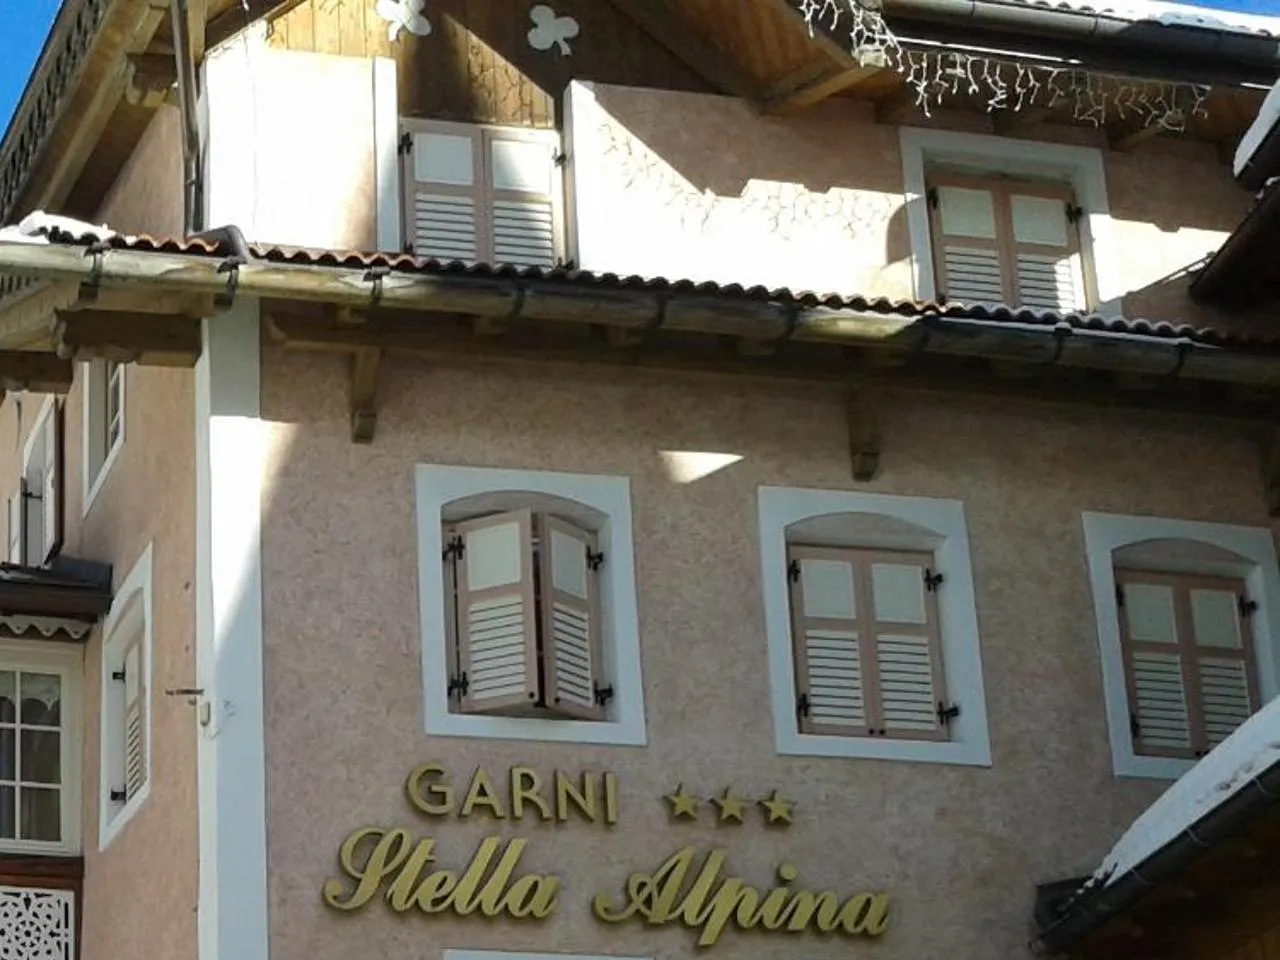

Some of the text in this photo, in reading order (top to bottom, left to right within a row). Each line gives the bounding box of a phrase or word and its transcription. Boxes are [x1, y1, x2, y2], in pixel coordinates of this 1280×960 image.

[407, 764, 617, 823] GARNI
[323, 828, 890, 947] Stella Alpina
